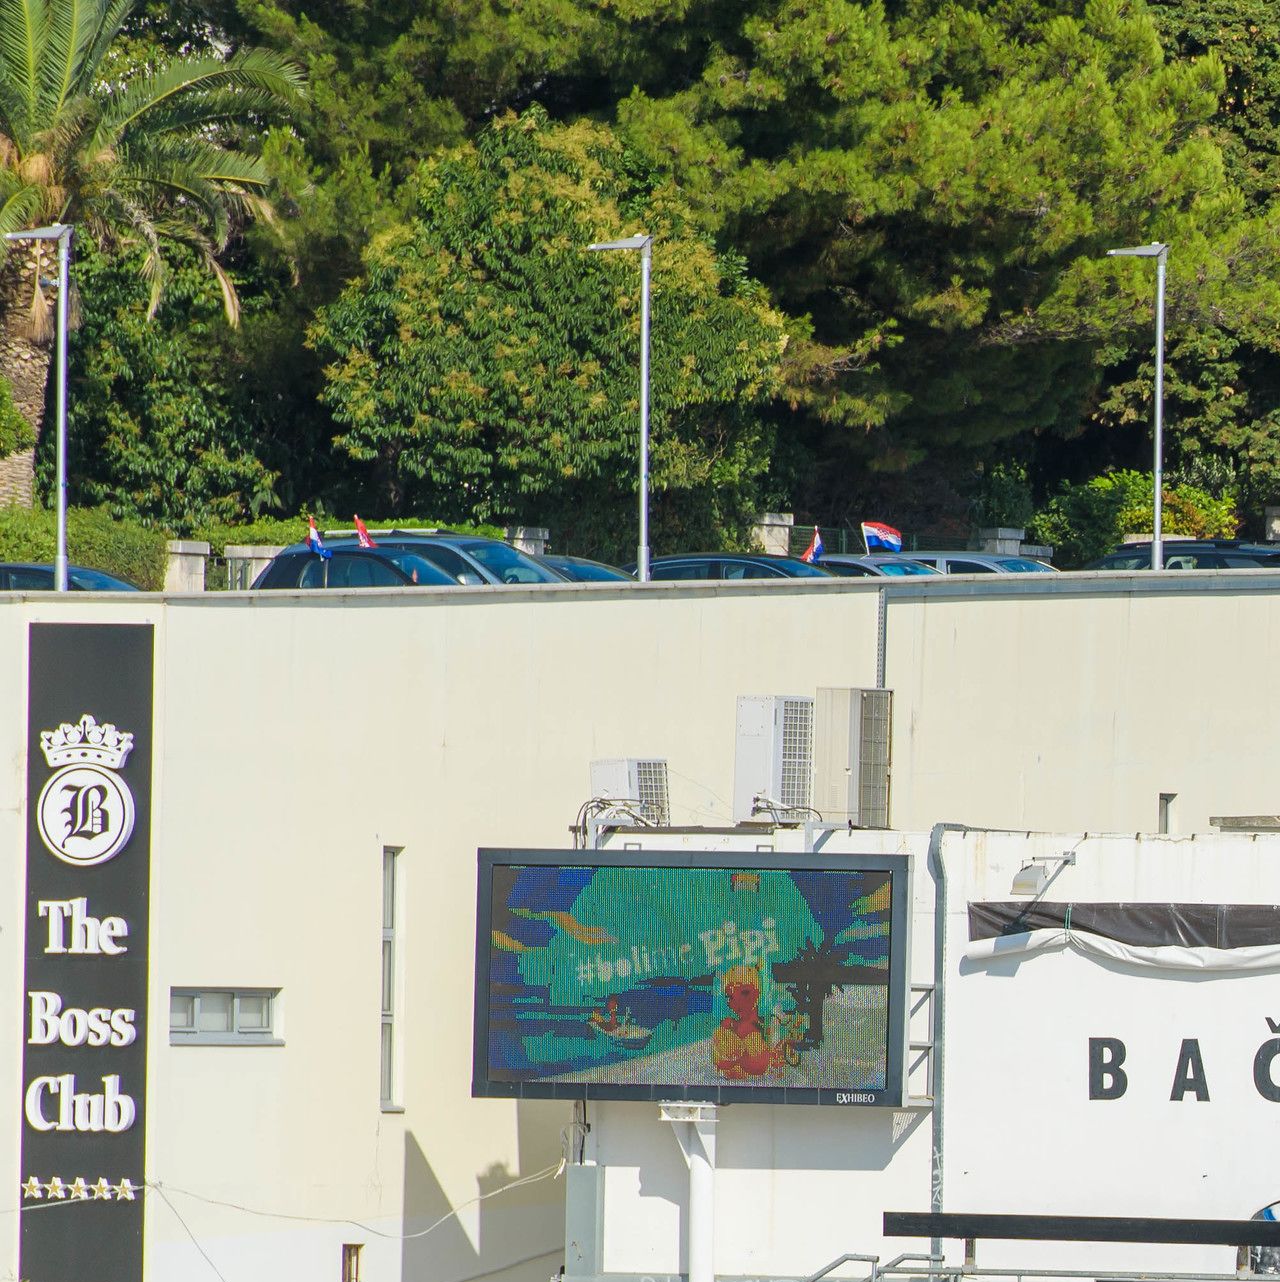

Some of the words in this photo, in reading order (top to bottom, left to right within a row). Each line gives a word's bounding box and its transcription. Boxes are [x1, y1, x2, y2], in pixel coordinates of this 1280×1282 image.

[37, 897, 129, 956] The
[27, 990, 137, 1048] Boss
[24, 1073, 136, 1133] Club
[836, 1092, 875, 1104] EXHIBEO
